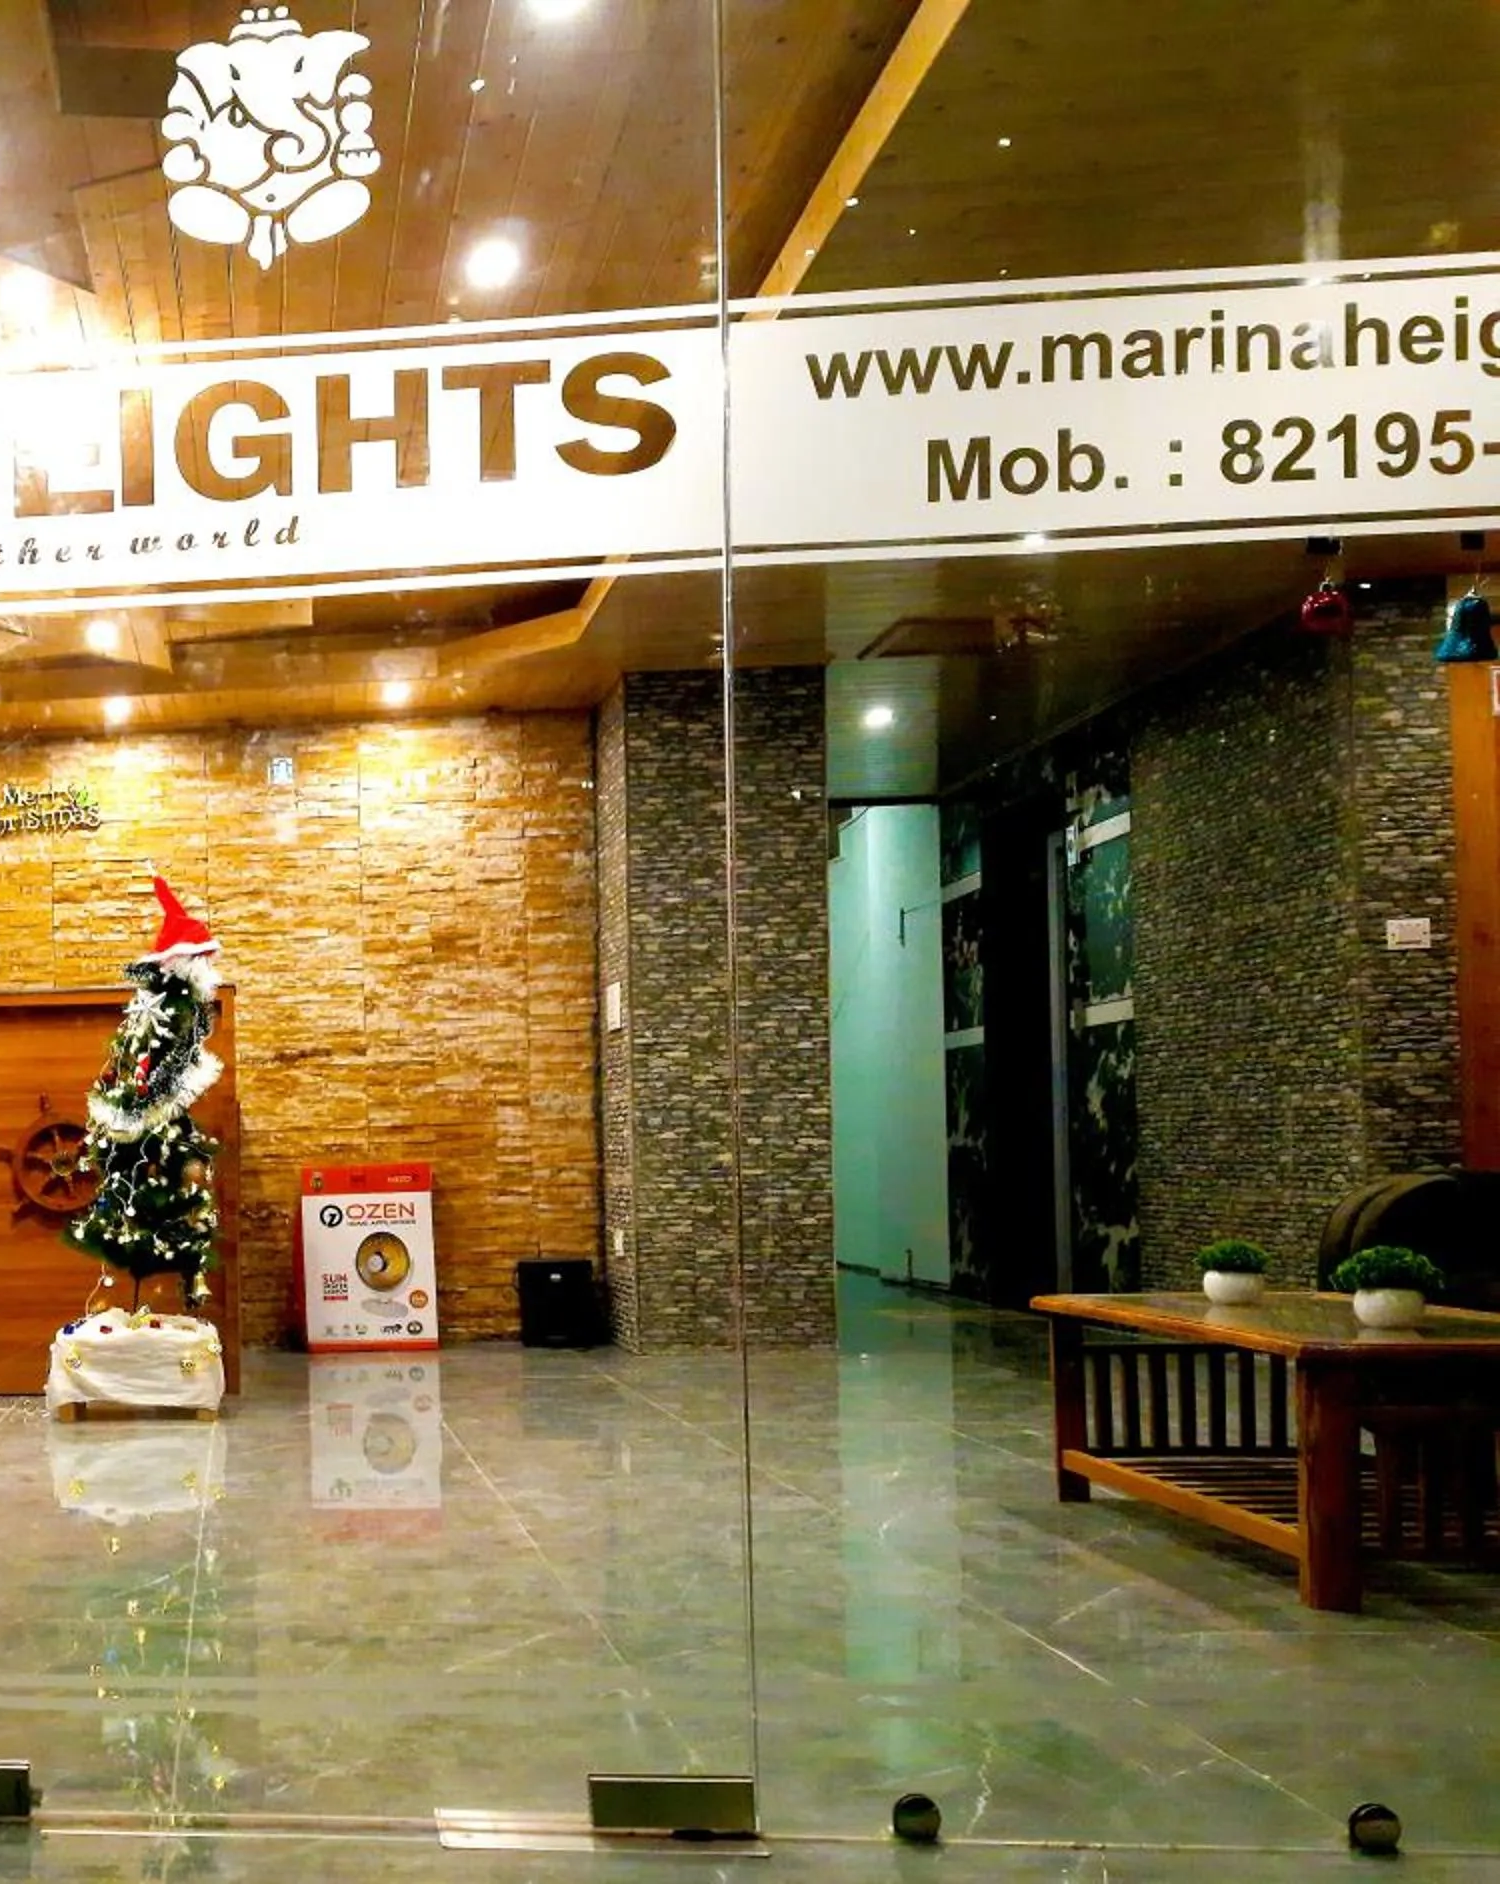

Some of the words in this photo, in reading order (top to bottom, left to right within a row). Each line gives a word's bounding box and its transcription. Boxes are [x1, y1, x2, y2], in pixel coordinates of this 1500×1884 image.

[926, 428, 1130, 503] Mob.
[129, 515, 300, 555] world
[346, 1203, 415, 1219] OZEN
